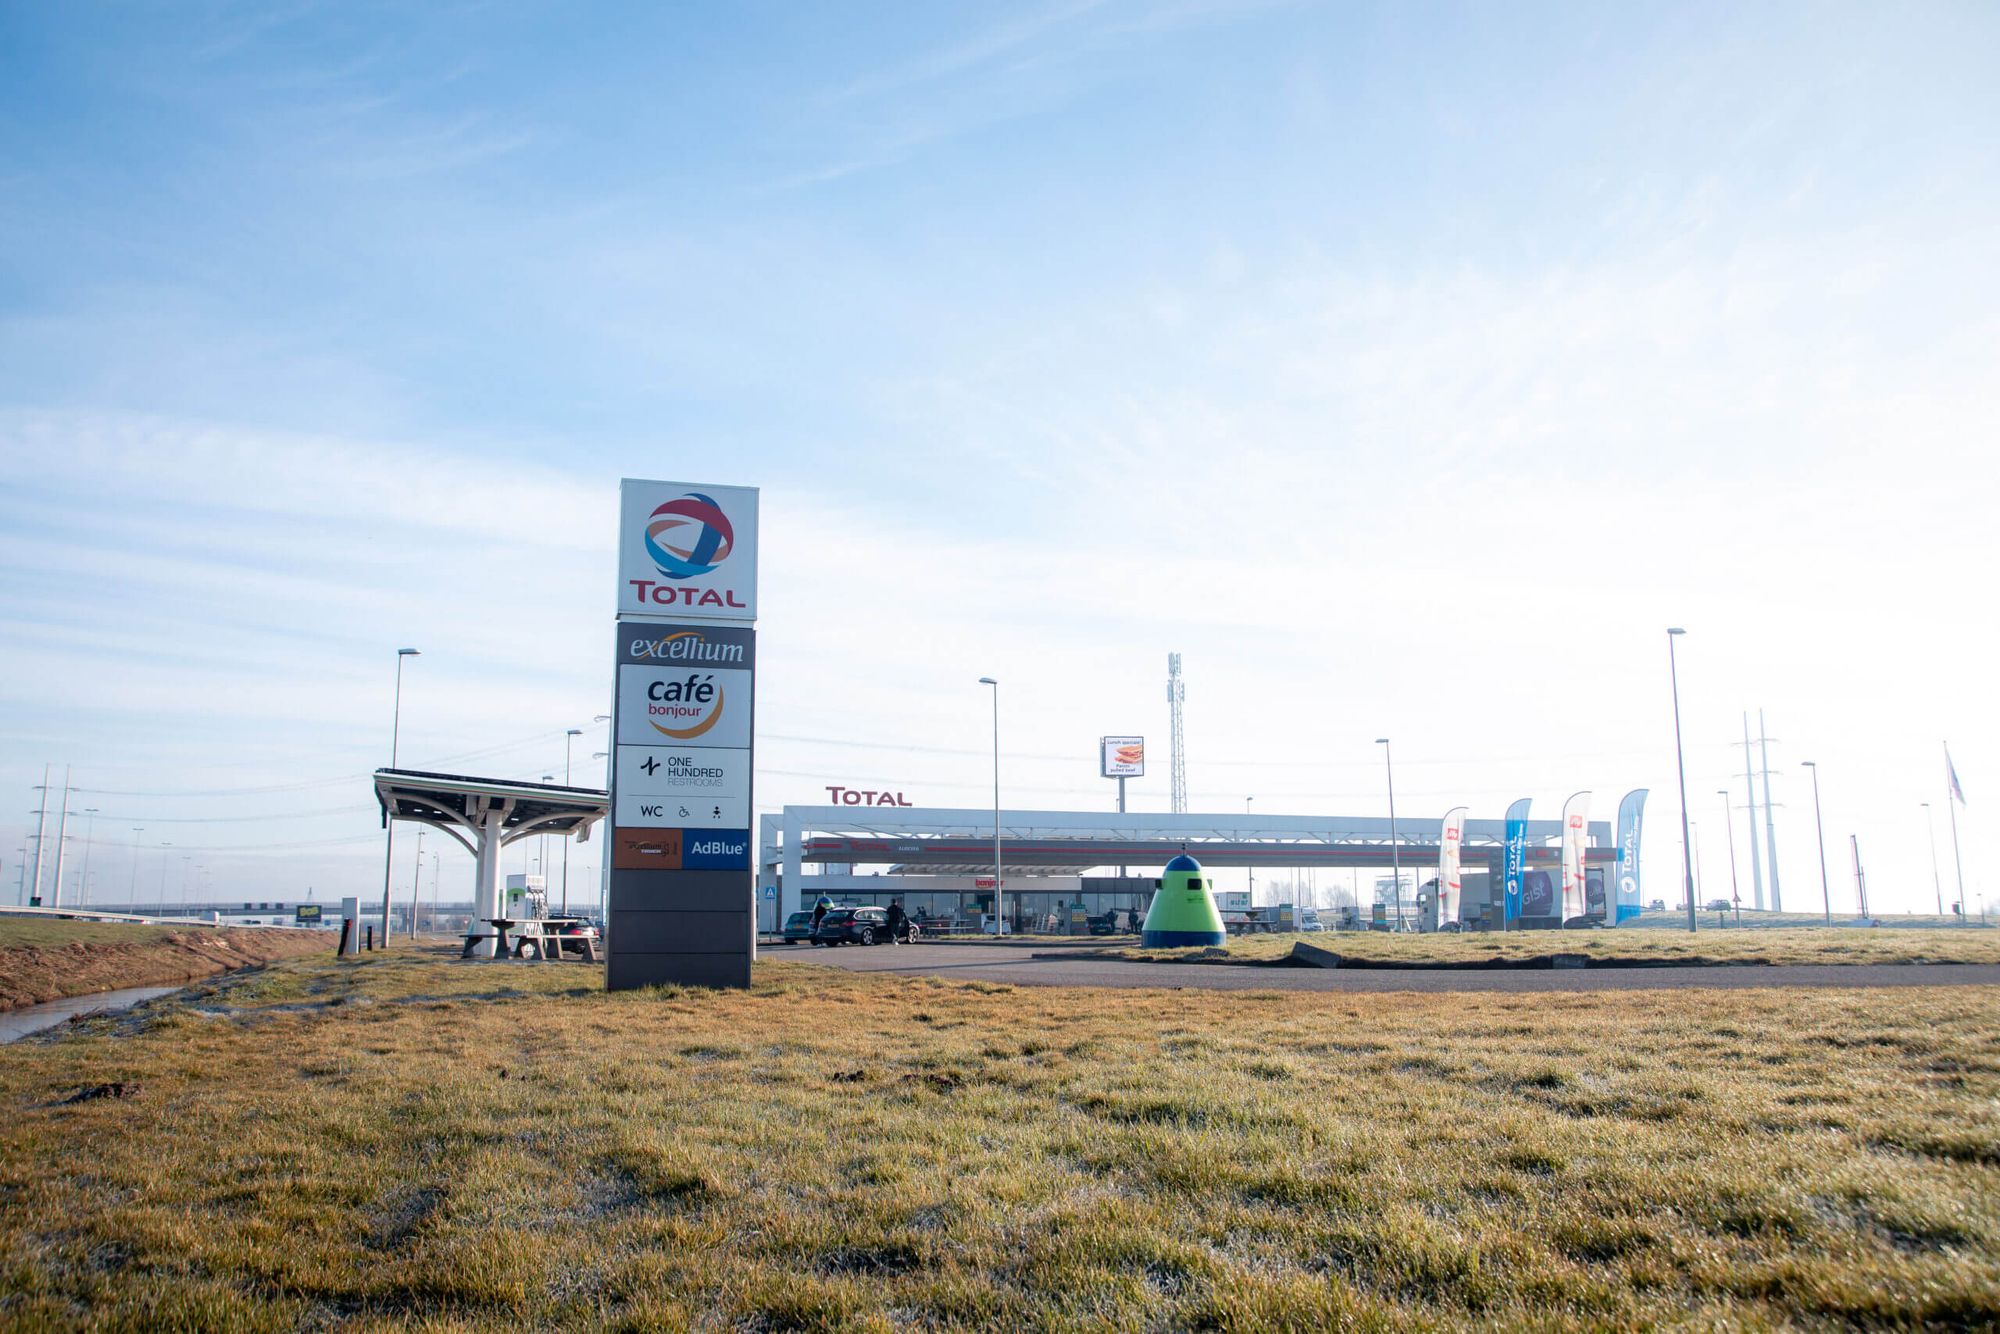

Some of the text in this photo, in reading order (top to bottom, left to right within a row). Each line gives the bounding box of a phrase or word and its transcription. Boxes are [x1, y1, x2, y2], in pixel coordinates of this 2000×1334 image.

[629, 580, 746, 608] TOTAL
[630, 637, 744, 662] excellium
[648, 674, 715, 703] café
[648, 703, 702, 719] bonjour
[668, 756, 693, 767] ONE
[668, 767, 724, 778] HUNDRED
[668, 778, 724, 787] RESTROOMS
[825, 786, 913, 807] TOTAL
[640, 805, 664, 818] WC
[1508, 836, 1518, 877] TOTAL
[1622, 830, 1634, 875] TOTAL
